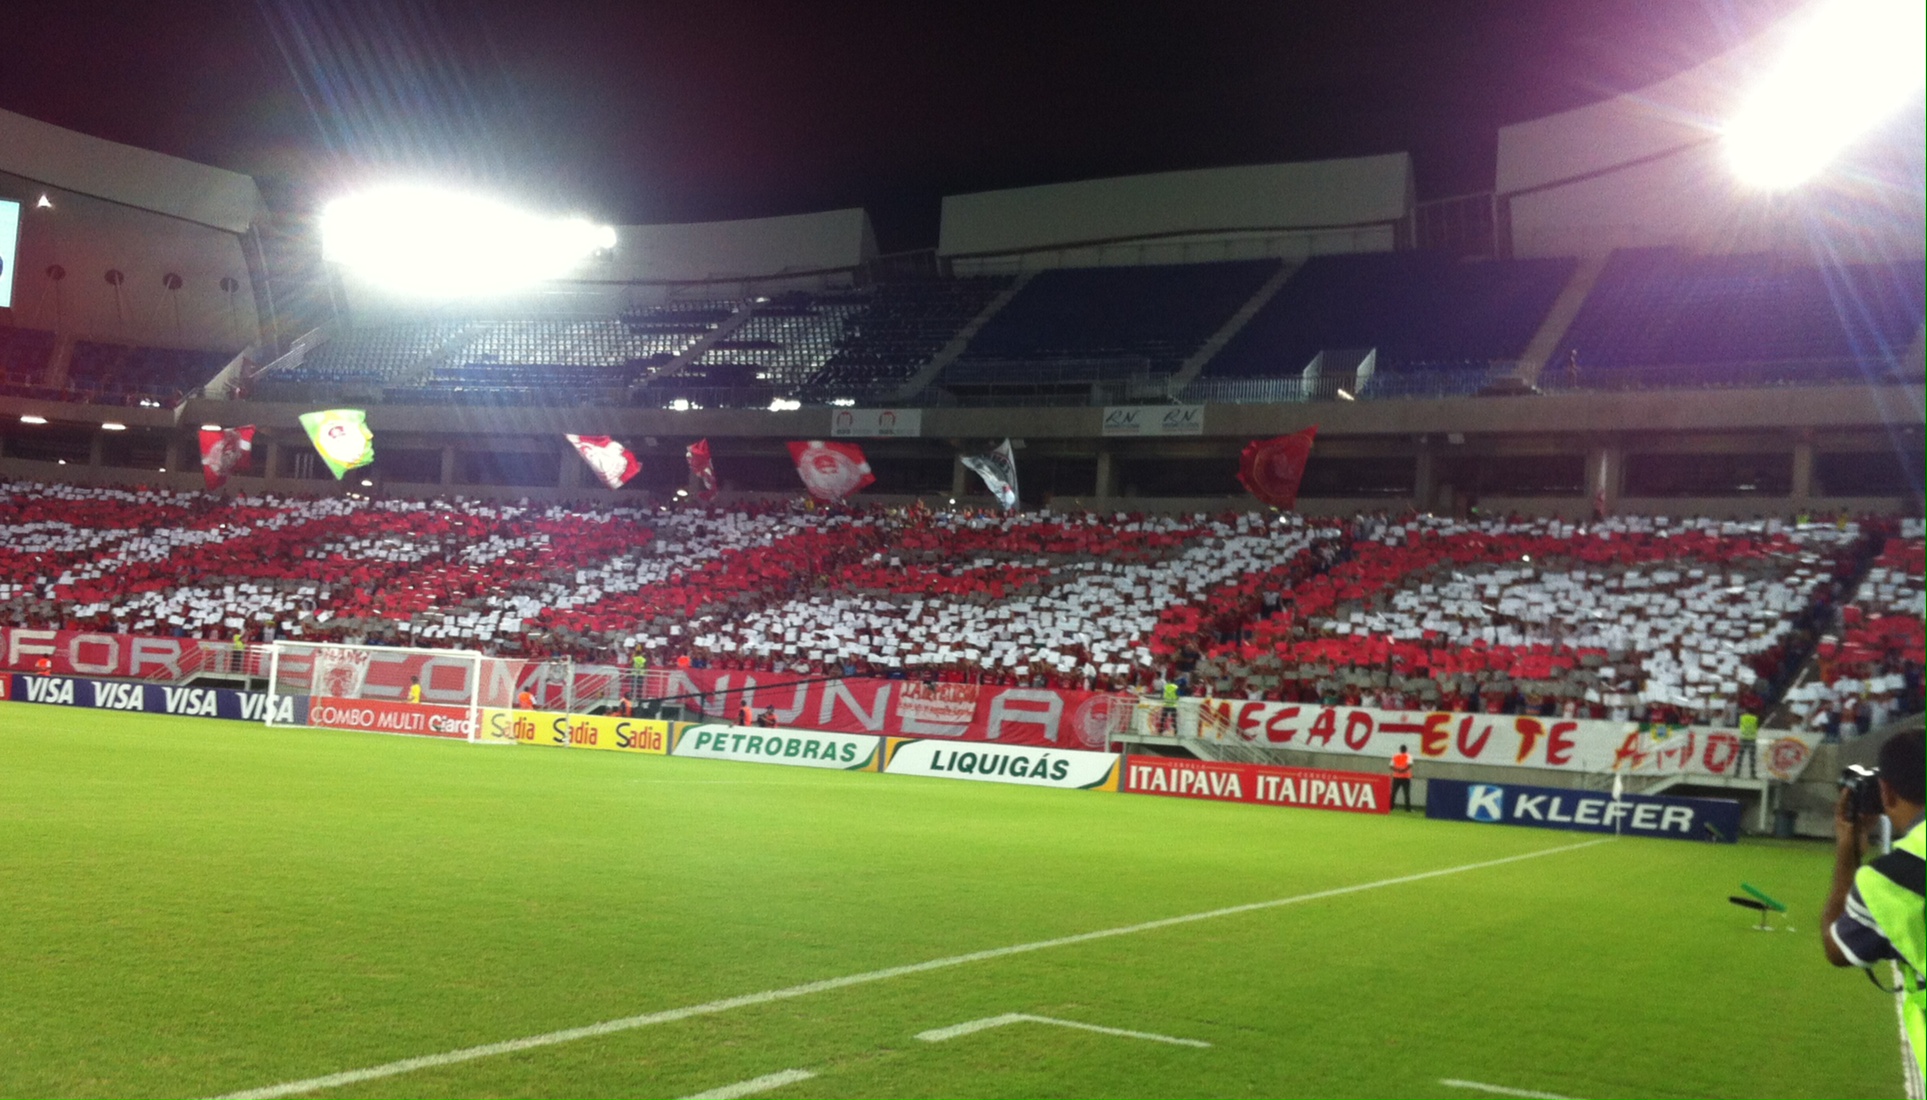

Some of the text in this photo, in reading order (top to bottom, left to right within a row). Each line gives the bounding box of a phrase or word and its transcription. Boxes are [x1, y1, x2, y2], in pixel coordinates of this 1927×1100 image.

[23, 676, 74, 704] VISA
[91, 681, 144, 711] VISA
[162, 686, 218, 716] VISA
[311, 706, 375, 727] COMBO
[377, 711, 425, 731] MULTI
[428, 714, 472, 734] Claro
[491, 713, 536, 740] Sadia
[553, 717, 598, 745] Sadia
[616, 722, 662, 750] Sadia
[694, 731, 858, 762] PETROBRAS
[1515, 715, 1579, 766] TE
[1612, 729, 1741, 774] AMO
[930, 750, 1070, 781] LIQUIGÁS
[1129, 765, 1243, 798] ITAIPAVA
[1255, 774, 1377, 810] ITAIPAVA
[1513, 794, 1695, 833] KLEFER
